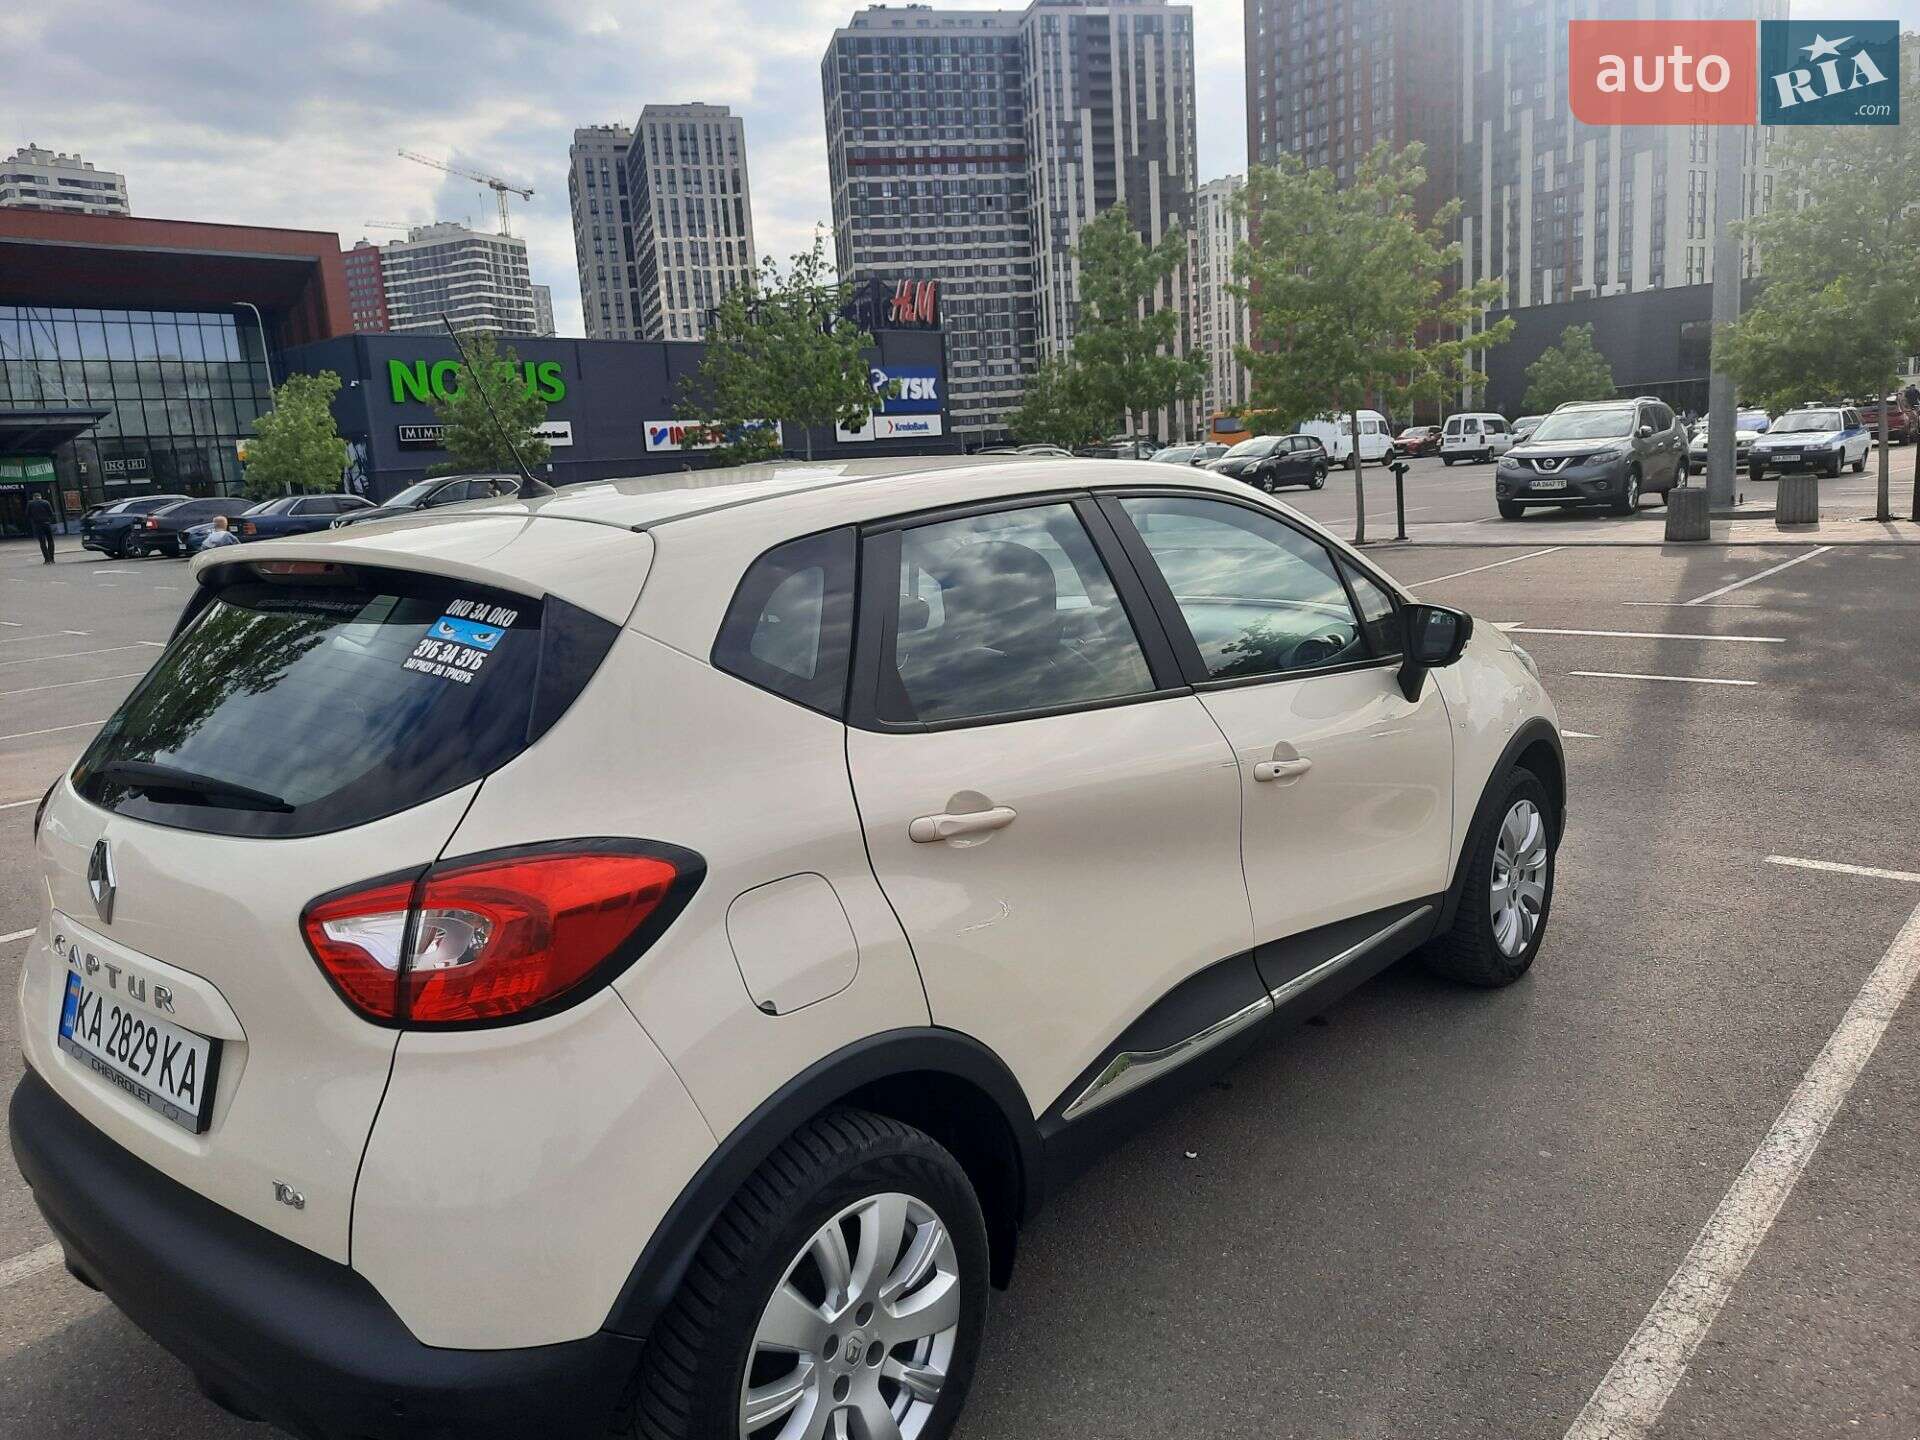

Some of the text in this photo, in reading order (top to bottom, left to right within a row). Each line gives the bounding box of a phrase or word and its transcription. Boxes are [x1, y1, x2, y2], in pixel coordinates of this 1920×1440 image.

[389, 359, 567, 403] NOUS
[445, 599, 518, 628] ОКО ЗА ОКО
[413, 638, 488, 671] ЗУБ ЗА ЗУБ
[54, 934, 175, 1014] CAPTUR
[75, 986, 196, 1105] KA 2829 KA
[91, 1058, 152, 1105] CHEVROLET
